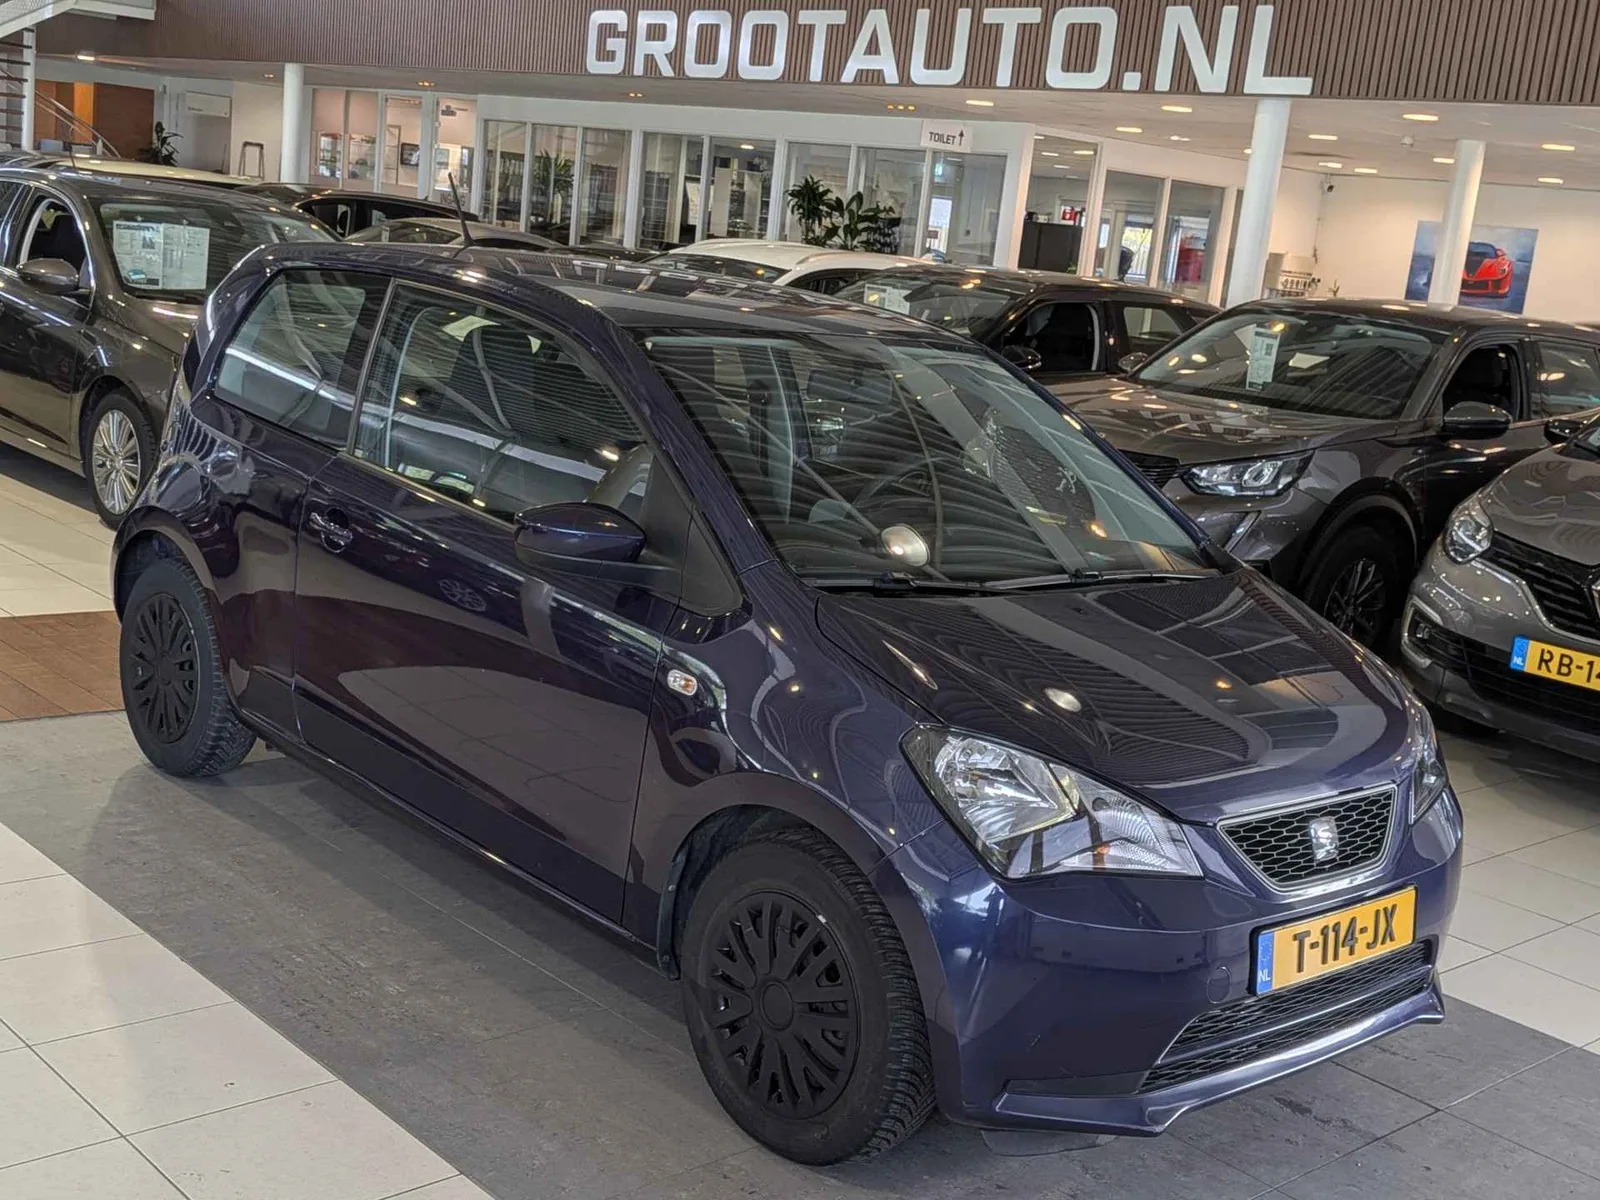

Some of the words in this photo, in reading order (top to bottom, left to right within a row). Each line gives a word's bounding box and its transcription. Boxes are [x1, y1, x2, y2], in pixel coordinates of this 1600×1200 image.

[586, 5, 1313, 95] GROOTAUTO.NL
[929, 131, 956, 145] TOILET
[1513, 655, 1524, 666] NL
[1292, 904, 1398, 974] T-114-JX
[1258, 970, 1271, 983] NL
